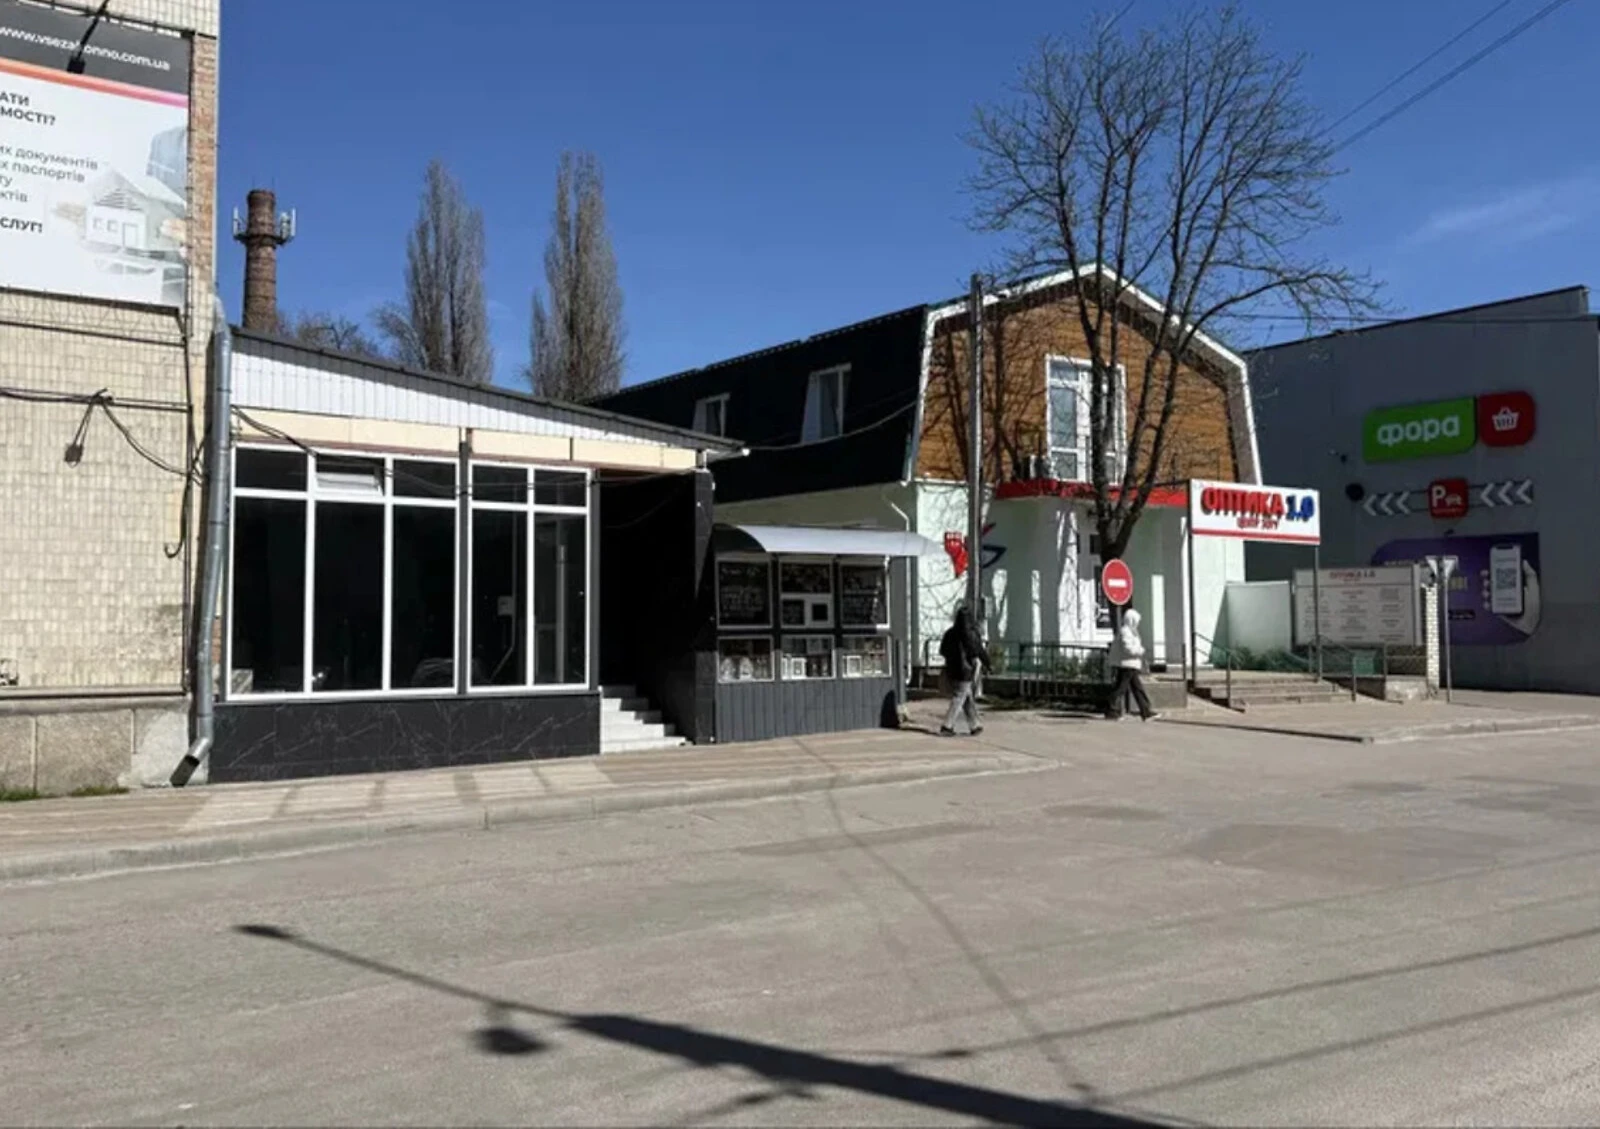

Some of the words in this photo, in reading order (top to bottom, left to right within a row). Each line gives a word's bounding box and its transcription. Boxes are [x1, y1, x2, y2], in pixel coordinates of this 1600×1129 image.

[15, 148, 98, 170] документів
[12, 162, 85, 182] паспортів
[1377, 414, 1460, 447] фора
[1200, 487, 1284, 518] ОПТИКА
[1286, 495, 1315, 522] 1.0
[1431, 484, 1447, 508] P
